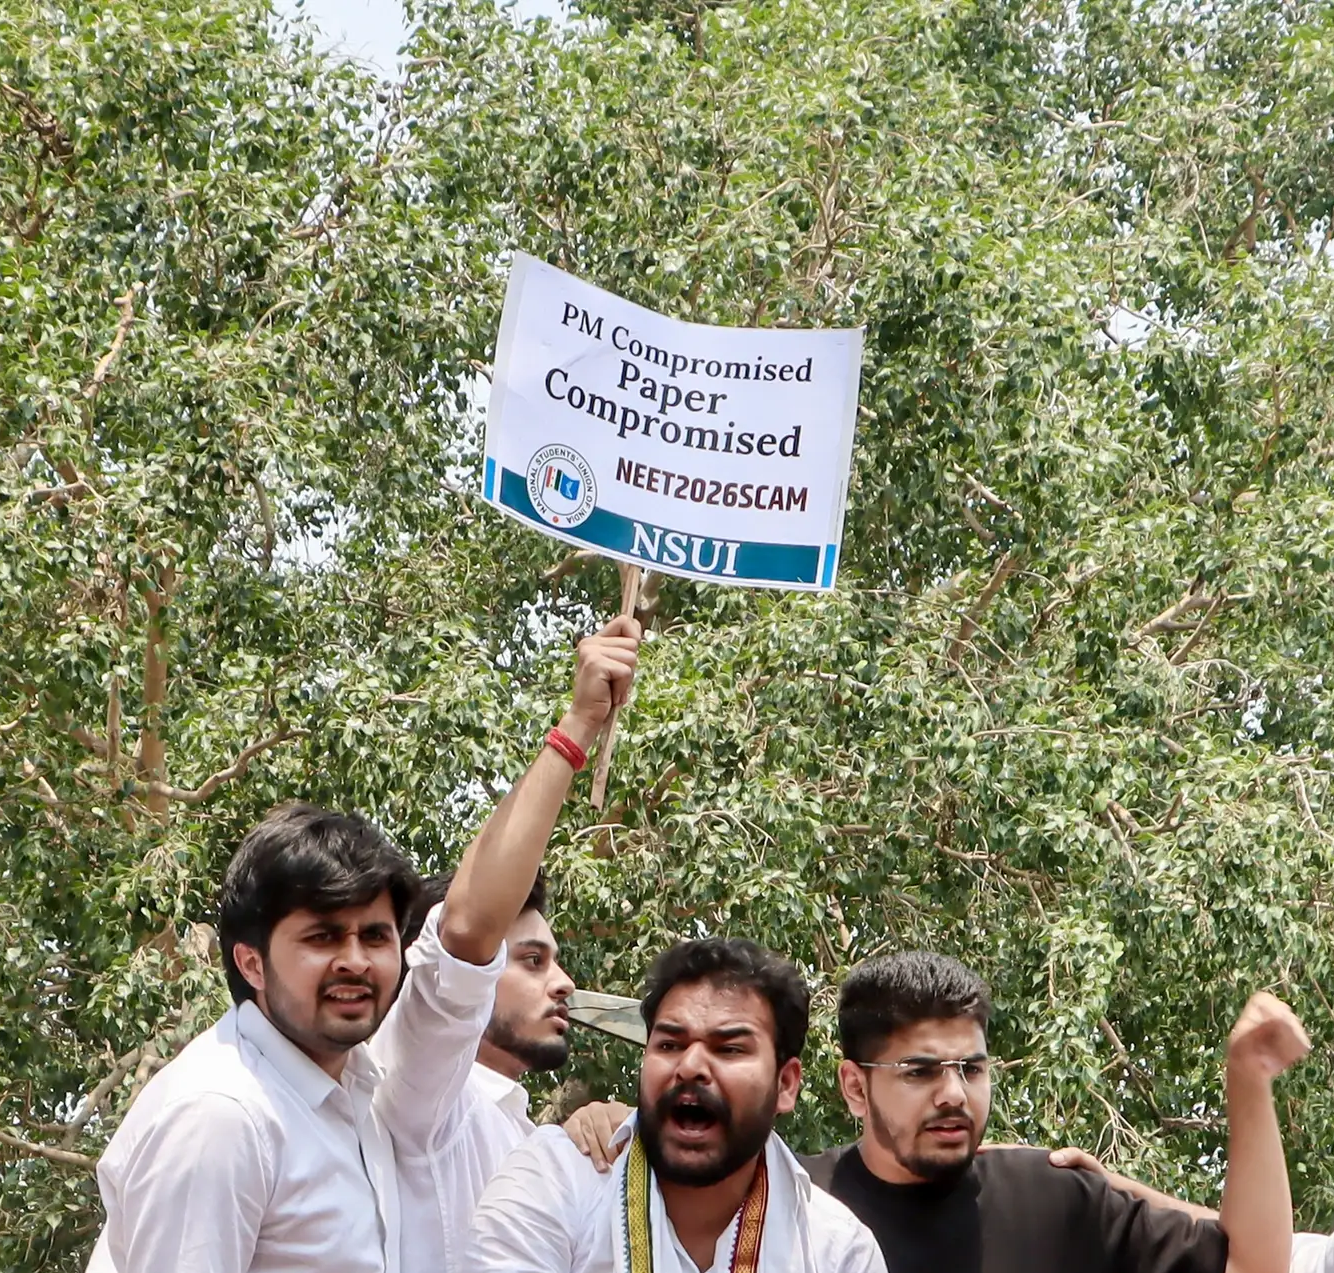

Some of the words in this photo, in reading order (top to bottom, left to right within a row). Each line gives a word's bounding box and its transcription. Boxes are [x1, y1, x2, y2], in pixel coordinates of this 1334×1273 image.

[561, 301, 605, 340] PM
[611, 325, 813, 382] Compromised
[544, 367, 802, 458] Compromised
[616, 358, 727, 415] Paper
[530, 467, 547, 514] NATIONAL
[578, 462, 593, 493] UNION
[585, 495, 593, 509] OF
[615, 456, 808, 512] NEET2026SCAM
[566, 508, 587, 524] INDIA
[629, 522, 741, 576] NSUI
